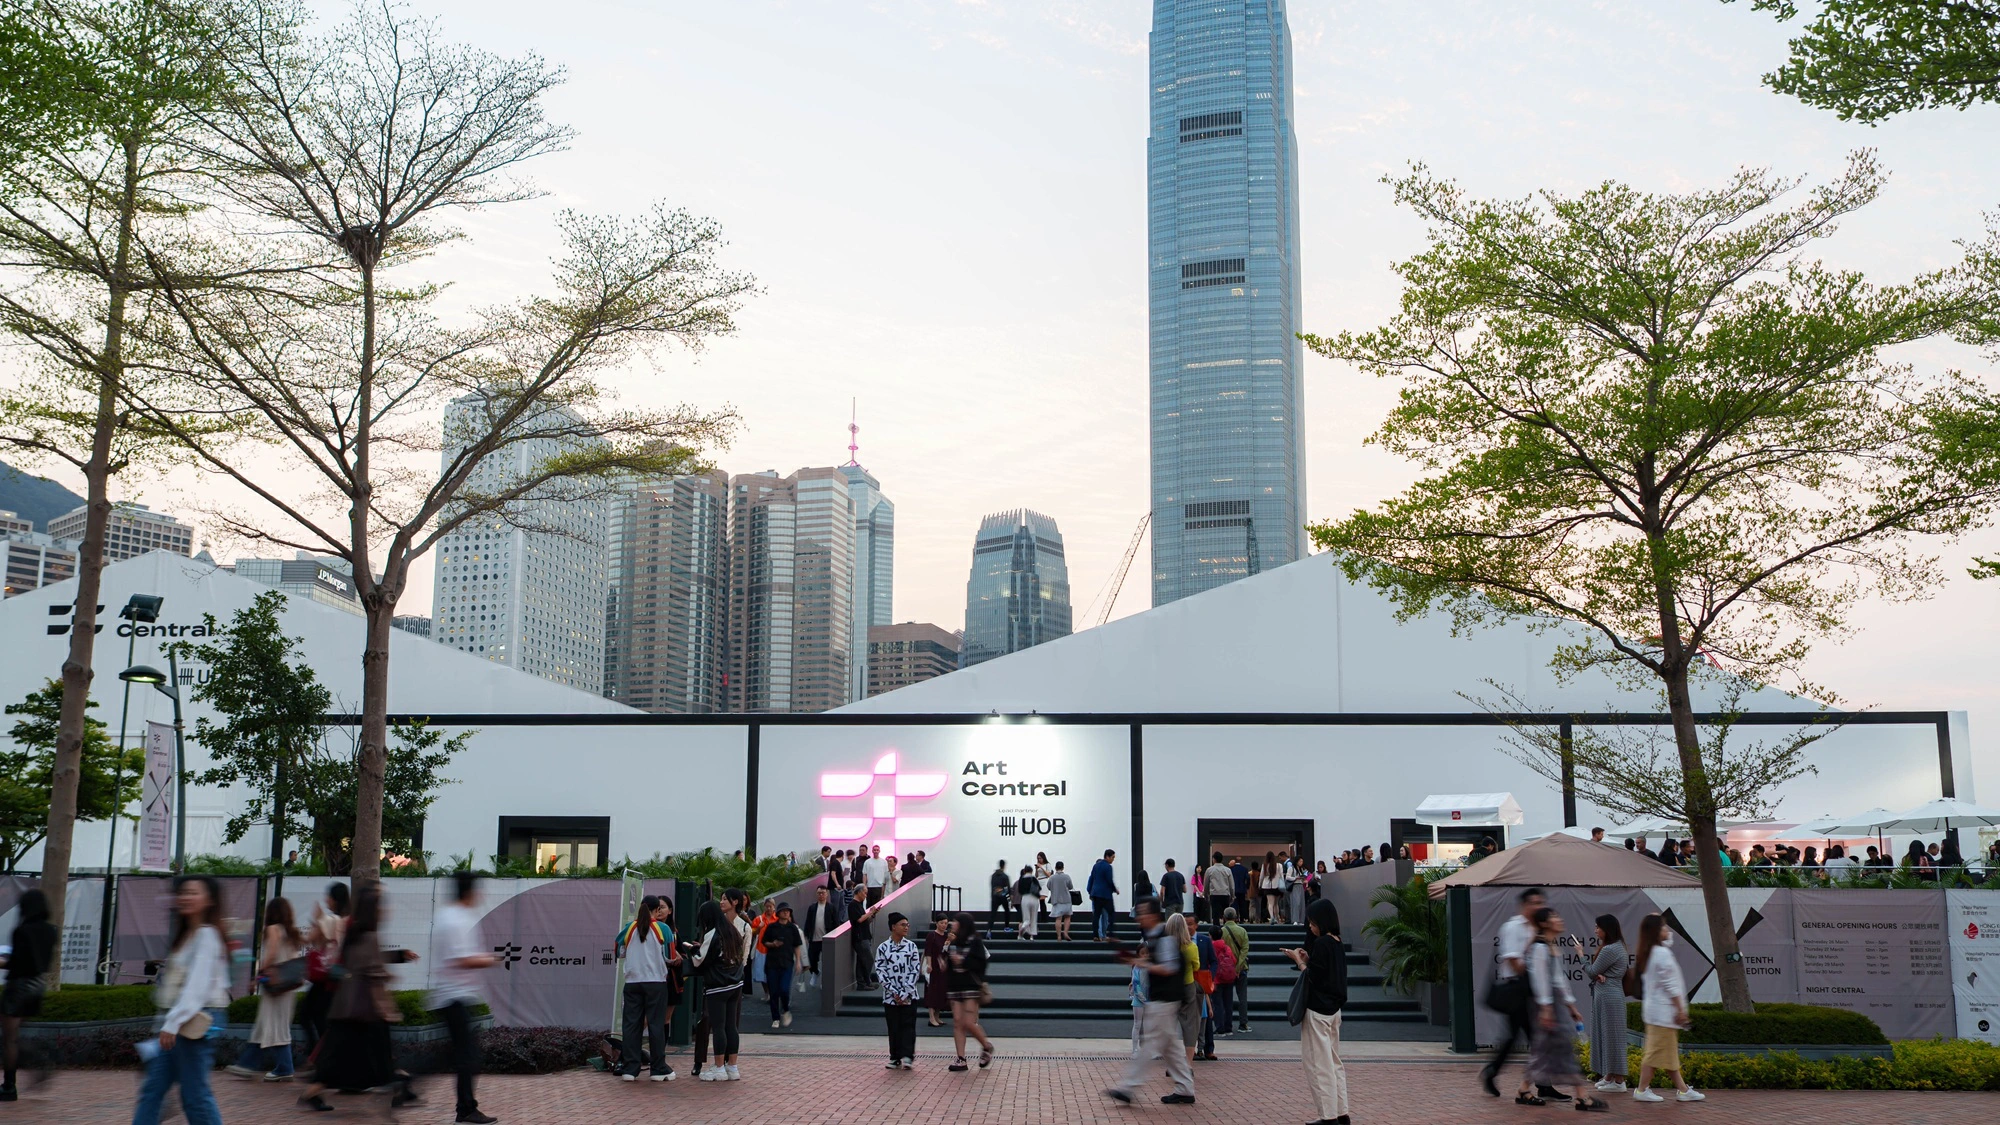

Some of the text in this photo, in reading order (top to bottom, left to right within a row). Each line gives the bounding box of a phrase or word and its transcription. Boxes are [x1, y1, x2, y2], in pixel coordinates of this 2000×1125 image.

[962, 760, 1007, 776] Art
[962, 780, 1066, 796] Central
[1022, 818, 1066, 835] UOB
[1552, 938, 1585, 946] ARCH
[530, 945, 554, 954] Art
[530, 956, 586, 965] Central
